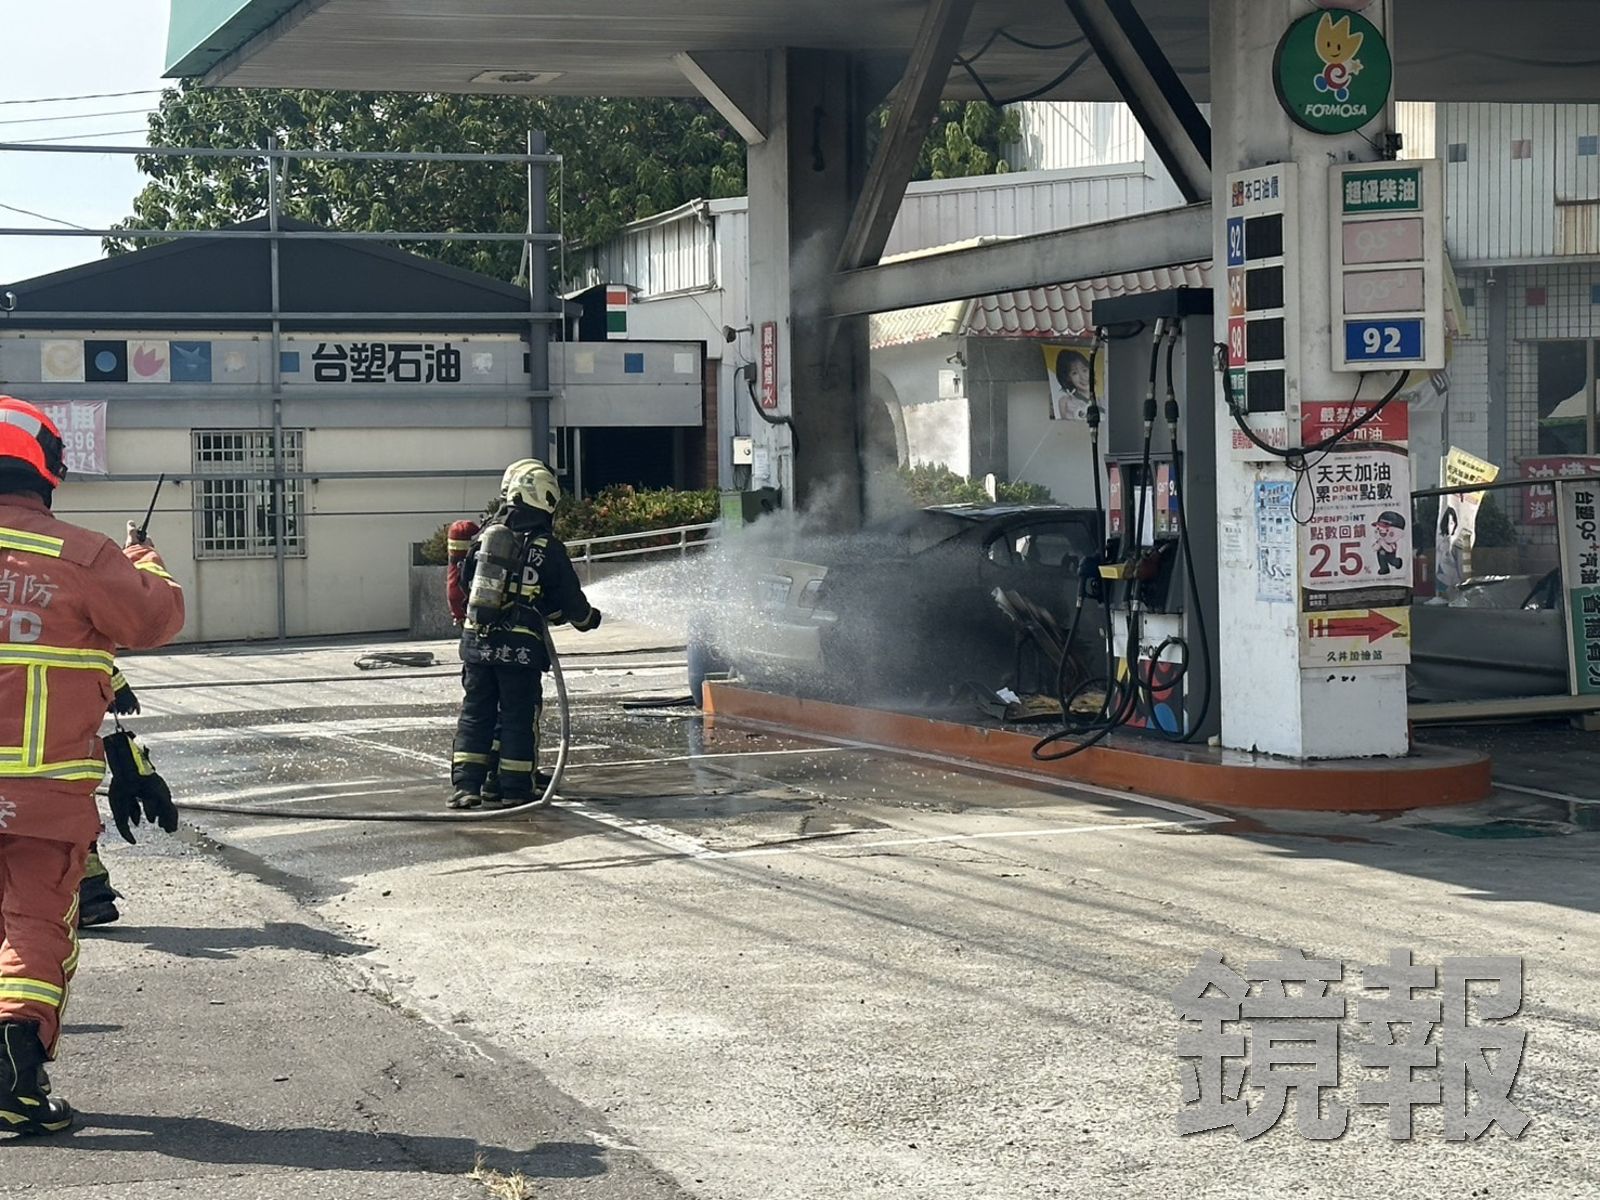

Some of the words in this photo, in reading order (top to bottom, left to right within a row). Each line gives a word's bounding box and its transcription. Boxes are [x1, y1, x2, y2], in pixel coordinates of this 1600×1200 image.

[1305, 104, 1367, 118] FORMOSA
[1245, 175, 1279, 202] 本日油價
[1345, 177, 1416, 204] 超級柴油
[1230, 225, 1241, 257] 92
[1231, 275, 1241, 307] 95
[1231, 325, 1242, 359] 98
[1362, 326, 1401, 354] 92
[311, 342, 461, 383] 台塑石油
[1317, 462, 1391, 483] 天天加油
[1310, 524, 1367, 541] 點數回饋
